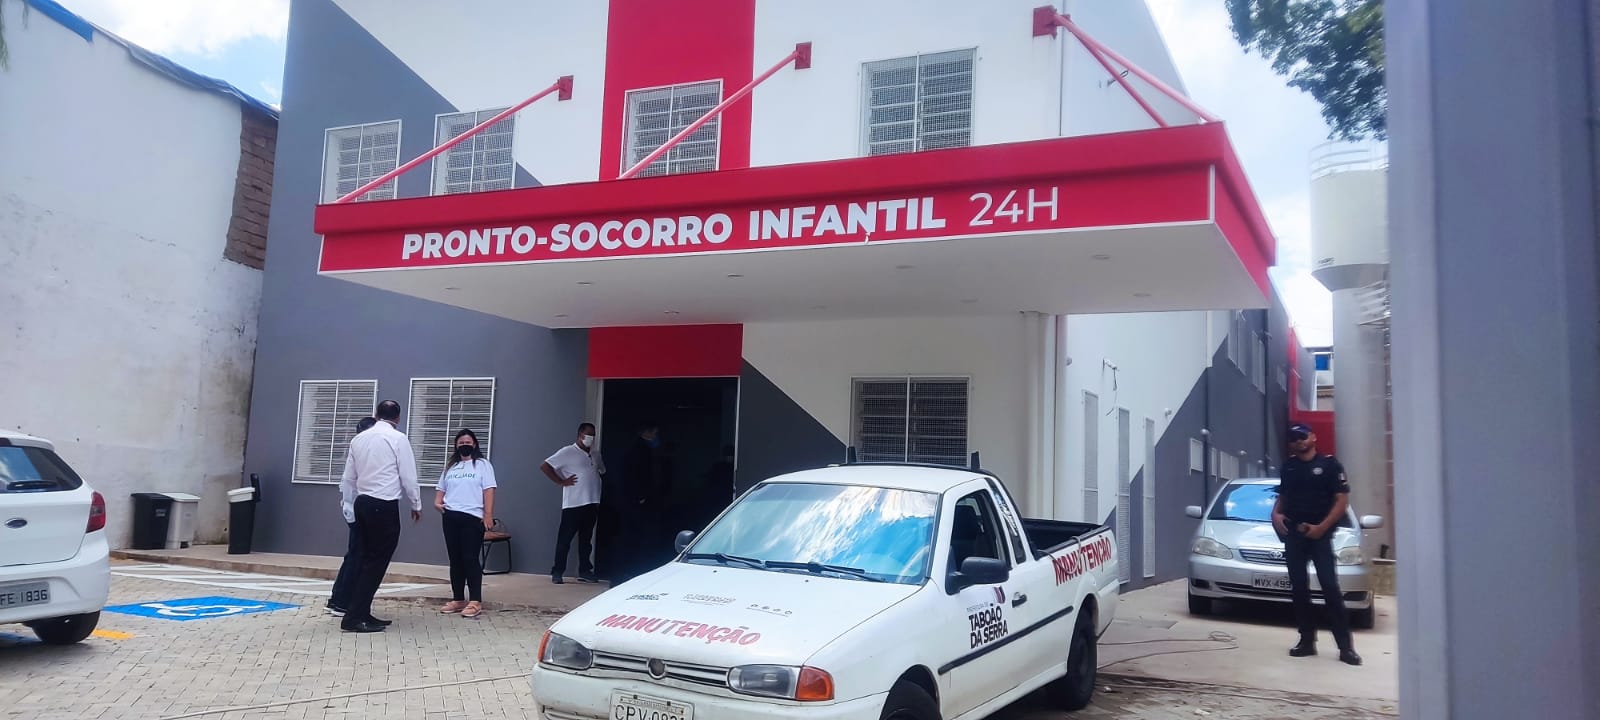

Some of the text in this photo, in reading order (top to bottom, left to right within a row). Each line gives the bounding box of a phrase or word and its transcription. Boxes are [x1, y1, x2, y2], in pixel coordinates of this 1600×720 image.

[402, 187, 1058, 260] PRONTO-SOCORRO INFANTIL 24H
[1052, 535, 1112, 586] MANUTENÇÃO
[595, 613, 761, 646] MANUTENÇÃO
[968, 603, 1003, 632] TABOÃO
[970, 619, 1009, 649] DA SERRA
